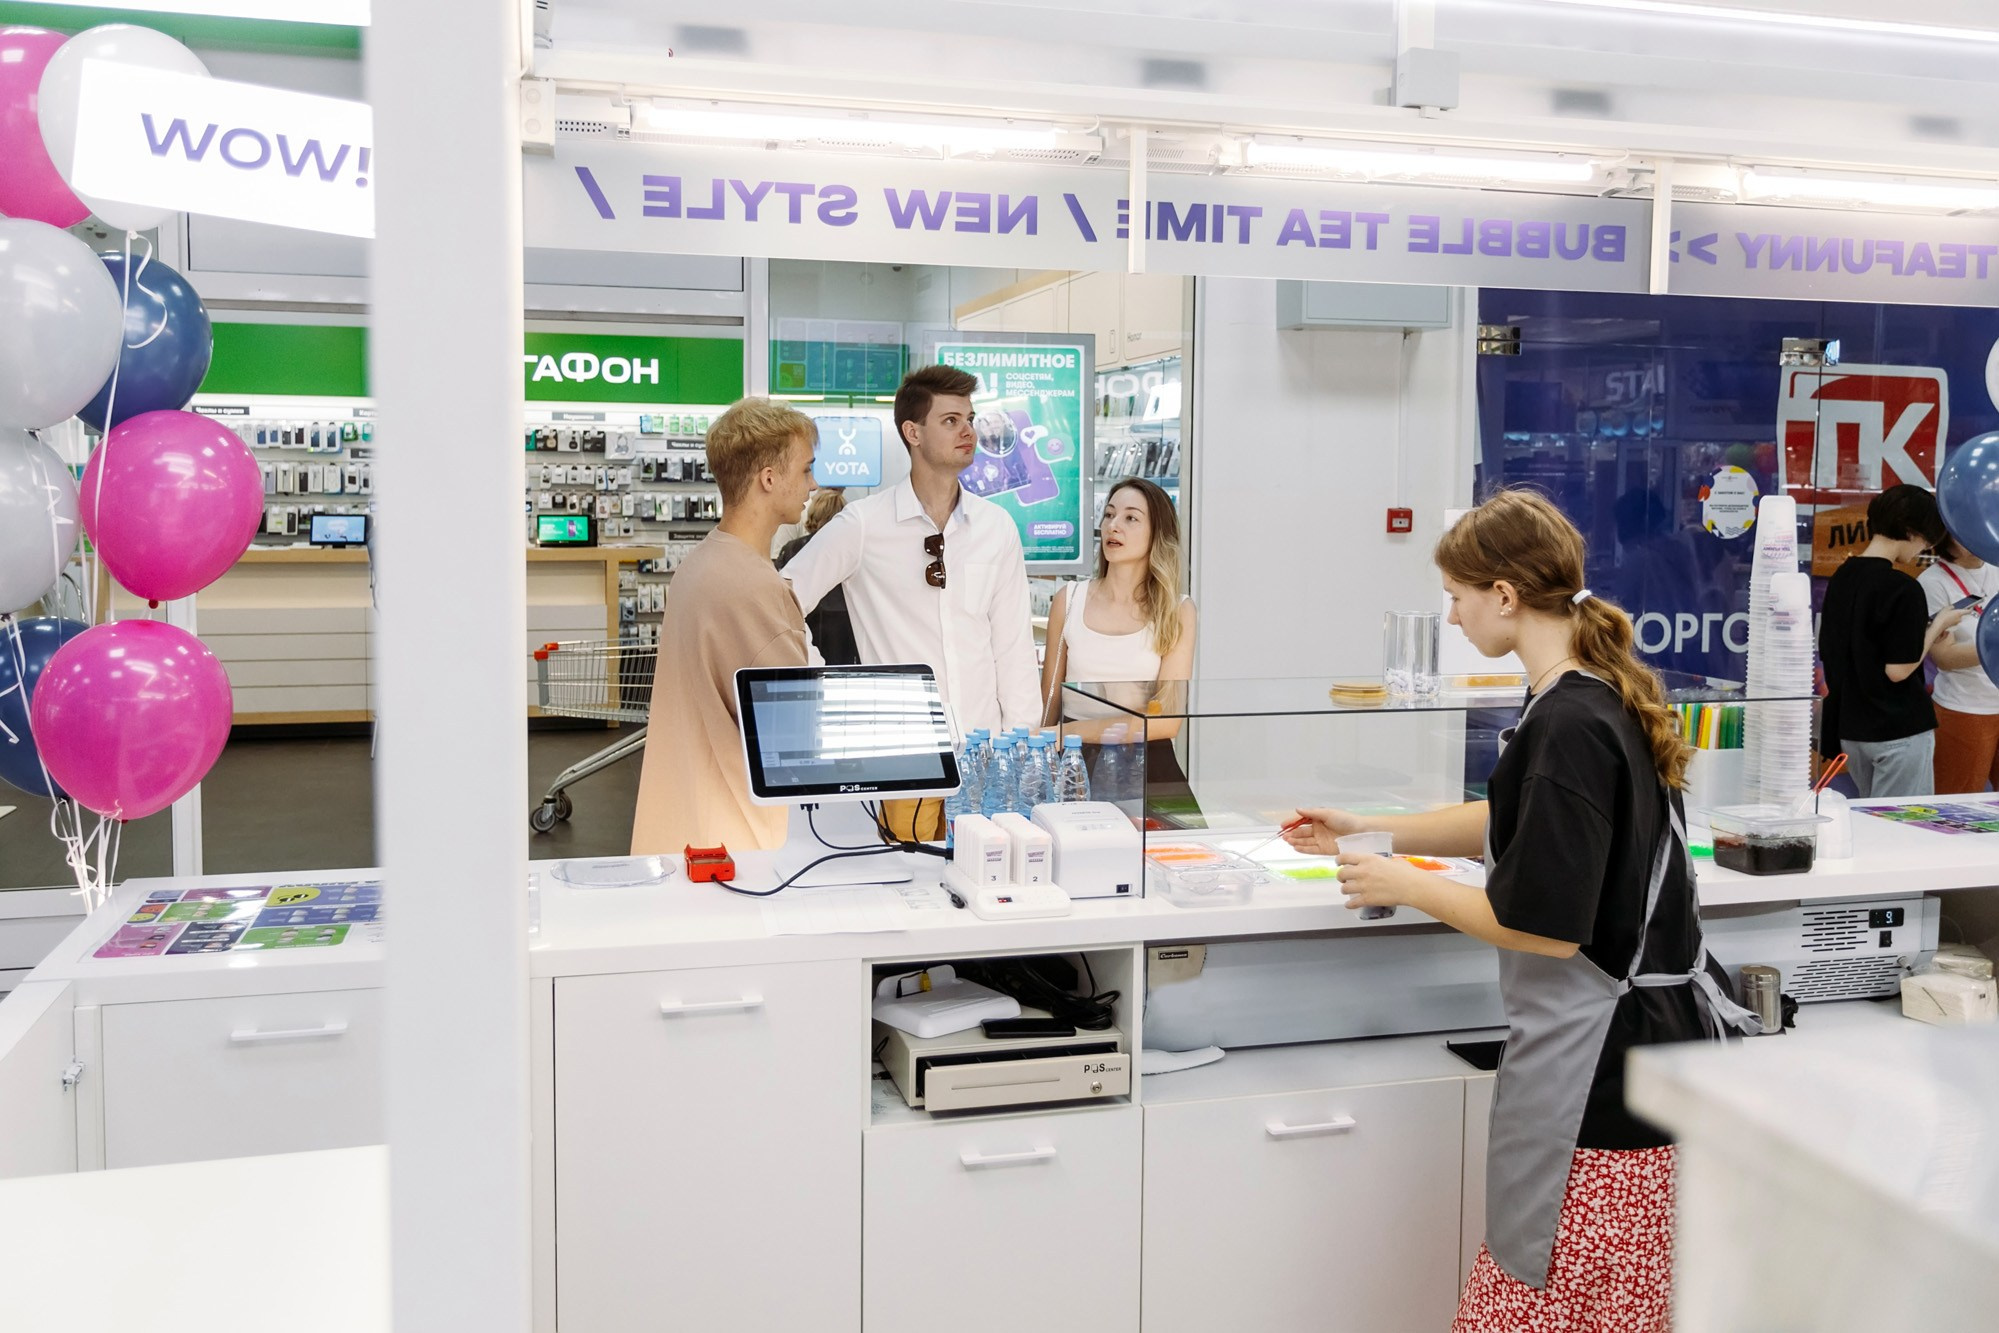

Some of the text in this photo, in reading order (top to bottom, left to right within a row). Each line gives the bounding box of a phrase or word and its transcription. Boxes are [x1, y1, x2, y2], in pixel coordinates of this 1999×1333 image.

[140, 112, 370, 189] WOW!
[943, 352, 1075, 368] БЕЗЛИМИТНОЕ
[1005, 389, 1075, 397] МЕССЕНДЖЕРАМ
[824, 461, 870, 476] YOTA
